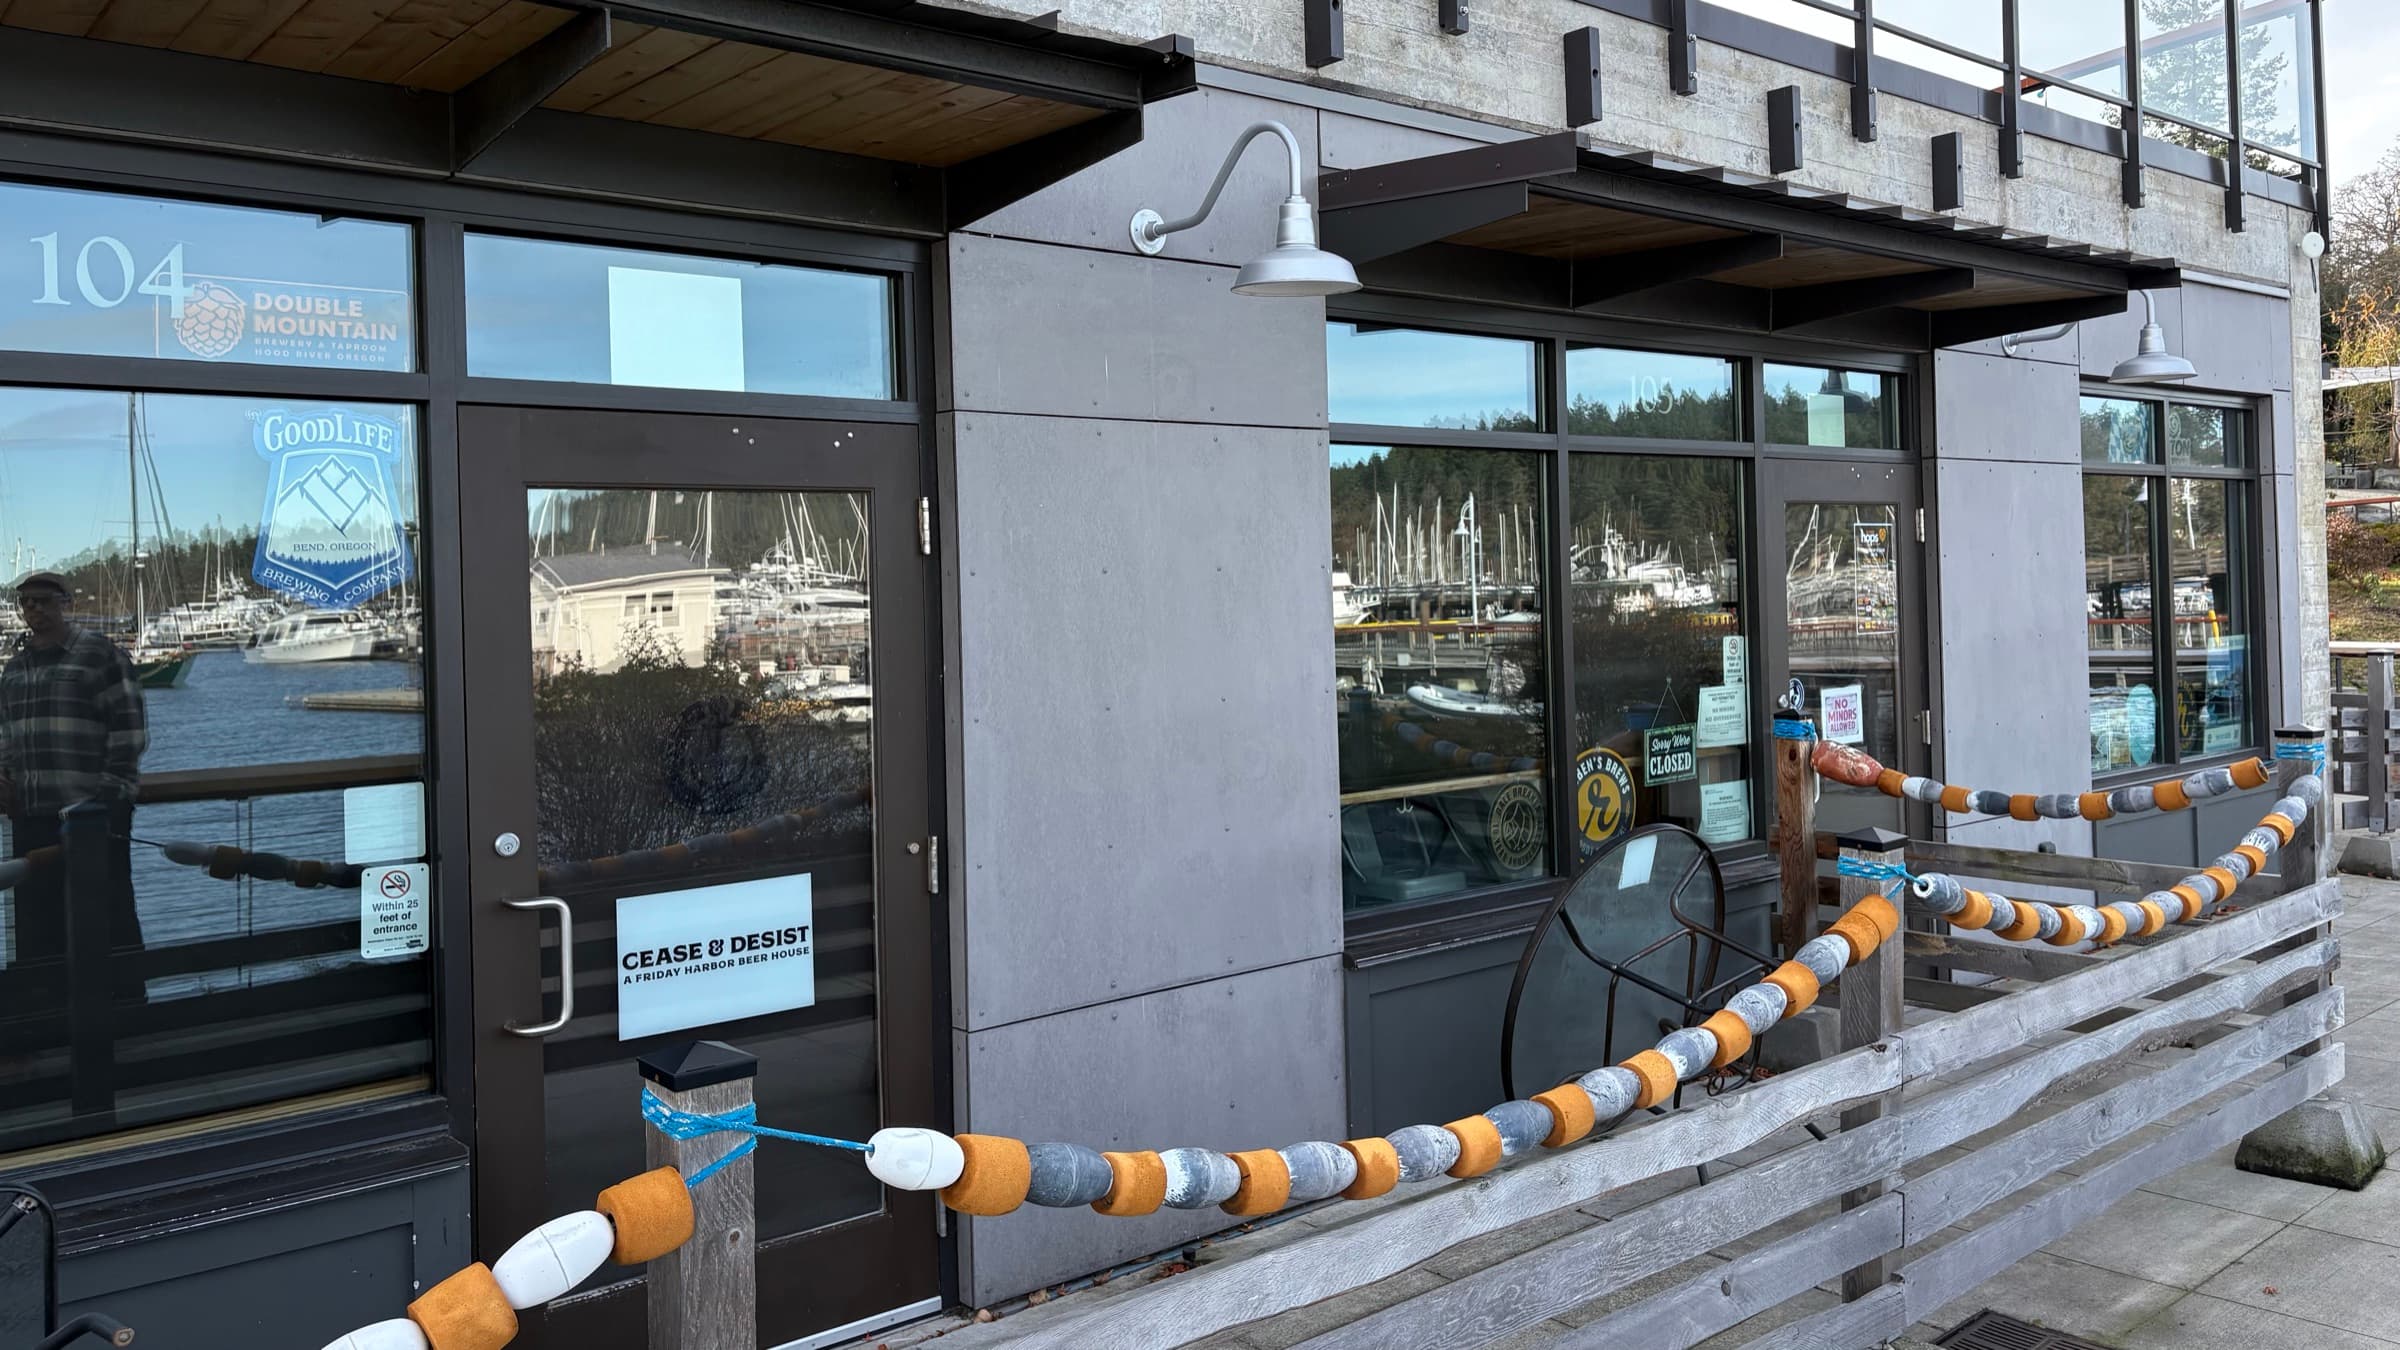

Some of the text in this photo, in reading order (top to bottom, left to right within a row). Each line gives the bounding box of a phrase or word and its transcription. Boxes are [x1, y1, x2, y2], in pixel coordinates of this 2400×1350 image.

[30, 231, 194, 319] 104
[254, 292, 363, 318] DOUBLE
[254, 314, 397, 341] MOUNTAIN
[254, 337, 312, 348] BREWERY
[331, 342, 387, 352] TAPROOM
[254, 349, 385, 363] HOOD RIVER OREGON
[1631, 375, 1673, 414] 105
[294, 542, 376, 552] BEND, OREGON
[263, 566, 406, 602] BREWING COMPANY
[1834, 699, 1848, 709] NO
[1828, 708, 1857, 723] MINORS
[1830, 721, 1856, 732] ALLOWED
[1651, 737, 1671, 754] Sorry
[1650, 752, 1692, 776] CLOSED
[1605, 757, 1630, 794] BREWS
[372, 899, 419, 912] Within 25
[380, 911, 412, 923] feet of
[373, 923, 418, 935] entrance
[622, 925, 809, 970] CEASE & DESIST
[623, 946, 810, 985] A FRIDAY HARBOR BEER HOUSE
